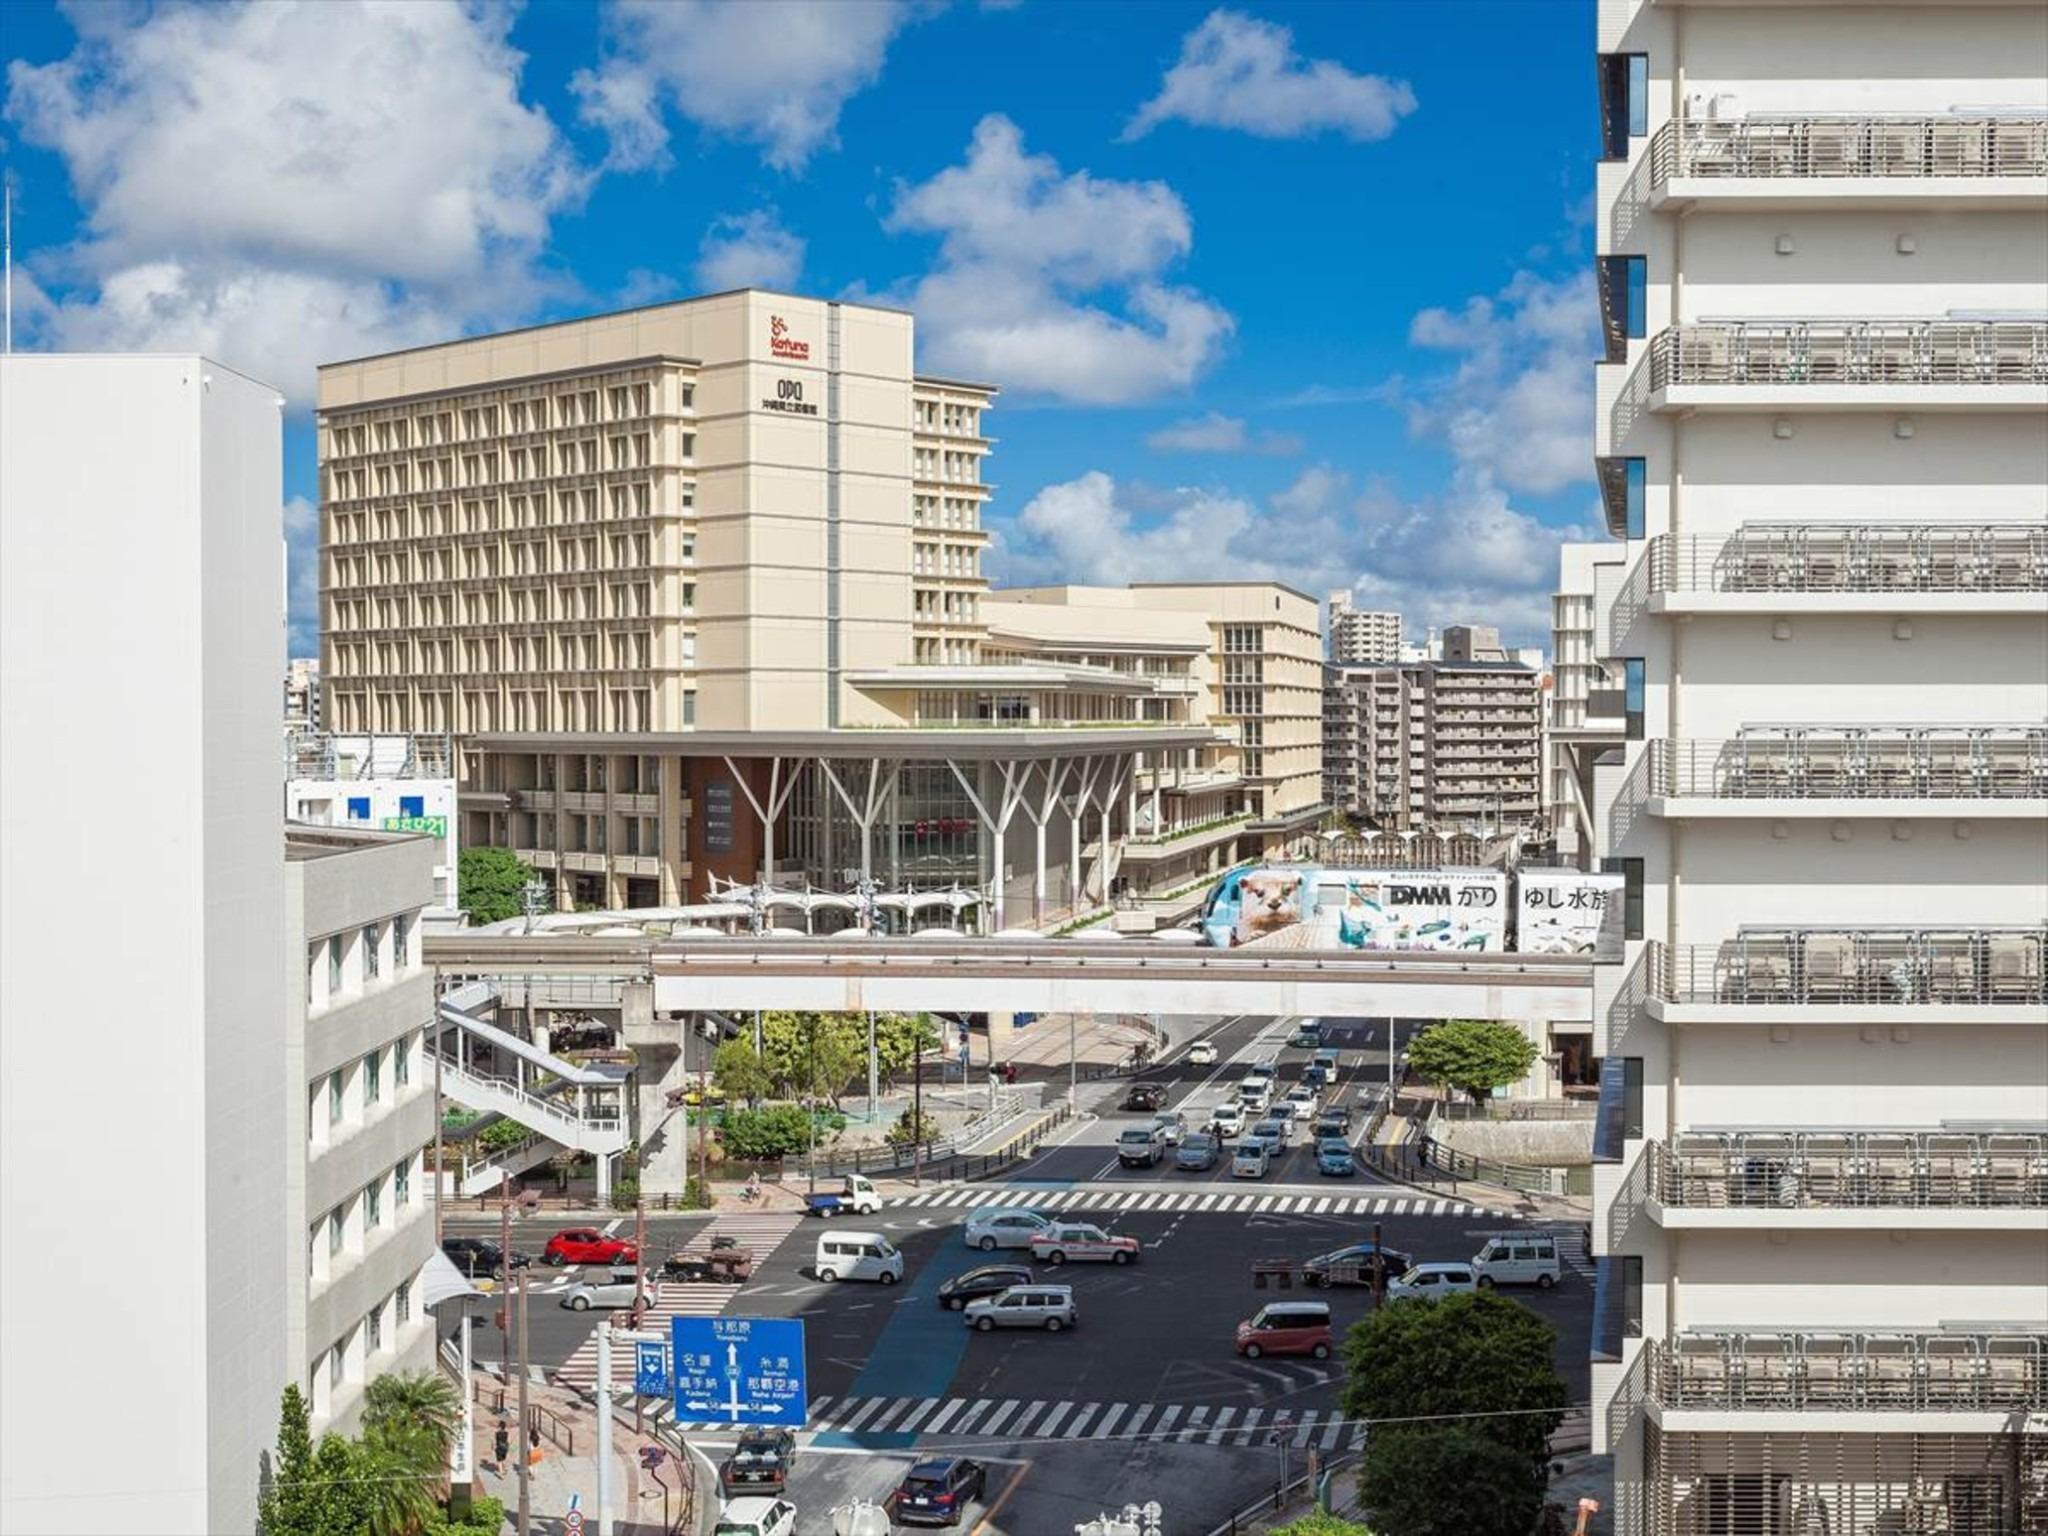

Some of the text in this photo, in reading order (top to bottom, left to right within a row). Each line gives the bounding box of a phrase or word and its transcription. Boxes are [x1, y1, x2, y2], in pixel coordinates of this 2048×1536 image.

[1390, 886, 1451, 905] DMM
[748, 1377, 800, 1392] 那覇空港
